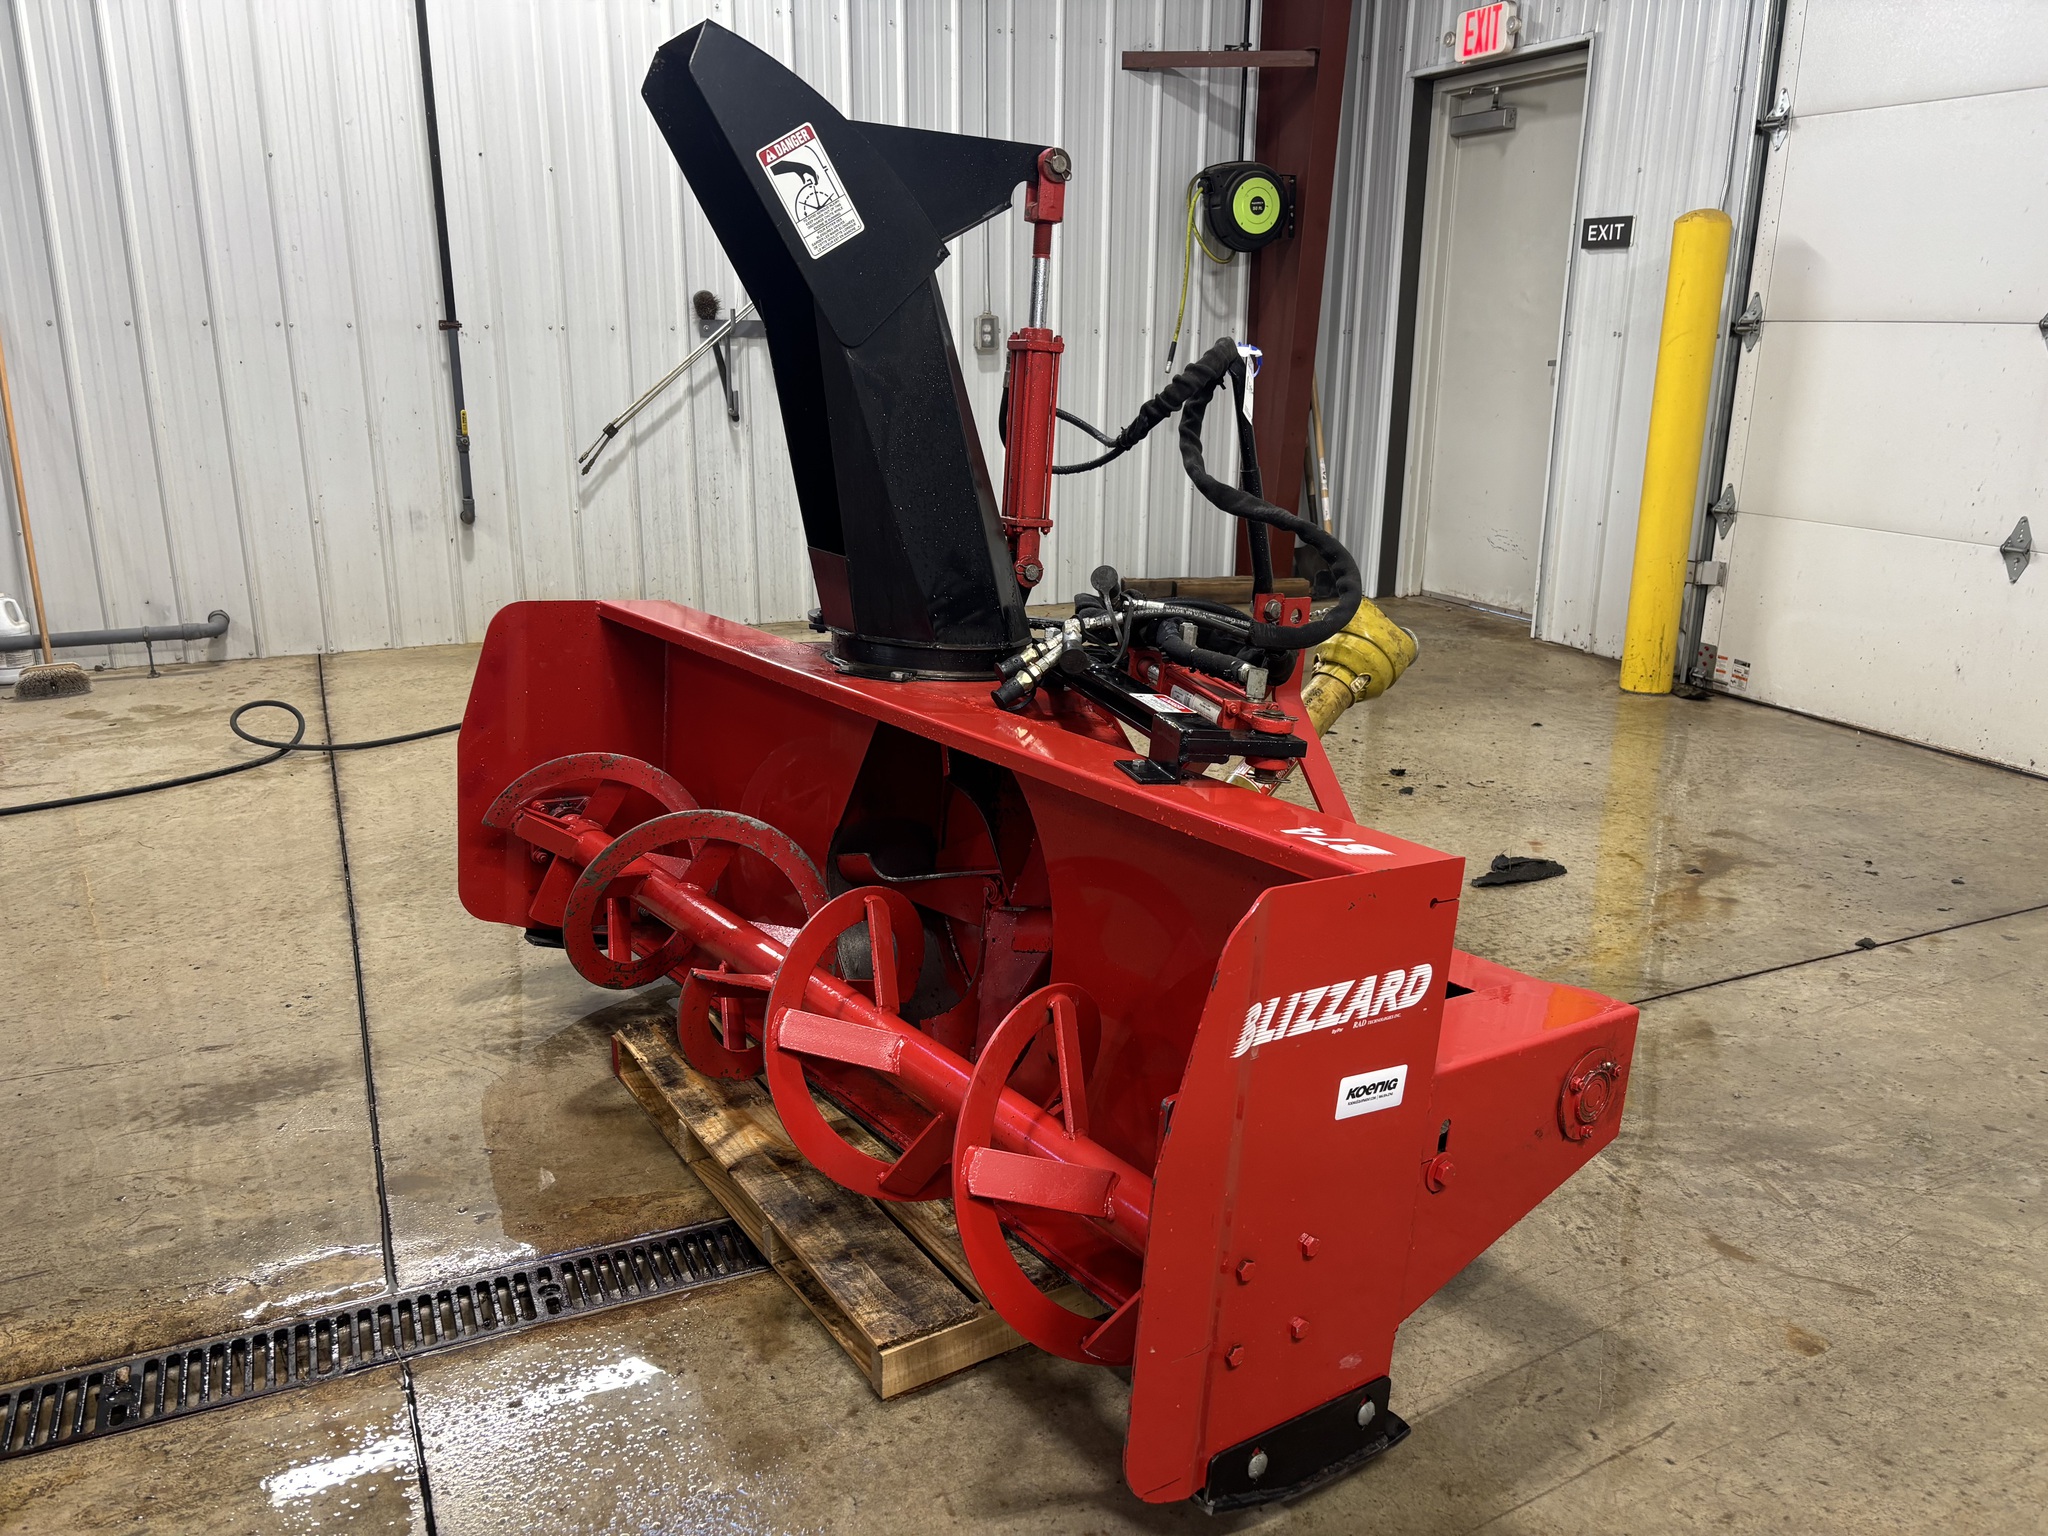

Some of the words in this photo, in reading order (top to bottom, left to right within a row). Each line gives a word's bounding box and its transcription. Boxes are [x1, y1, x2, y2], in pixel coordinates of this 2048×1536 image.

[1463, 3, 1502, 57] EXIT
[773, 128, 811, 157] DANGER
[1588, 223, 1625, 241] EXIT
[1229, 963, 1433, 1059] BLIZZARD
[1352, 1019, 1367, 1029] RAD
